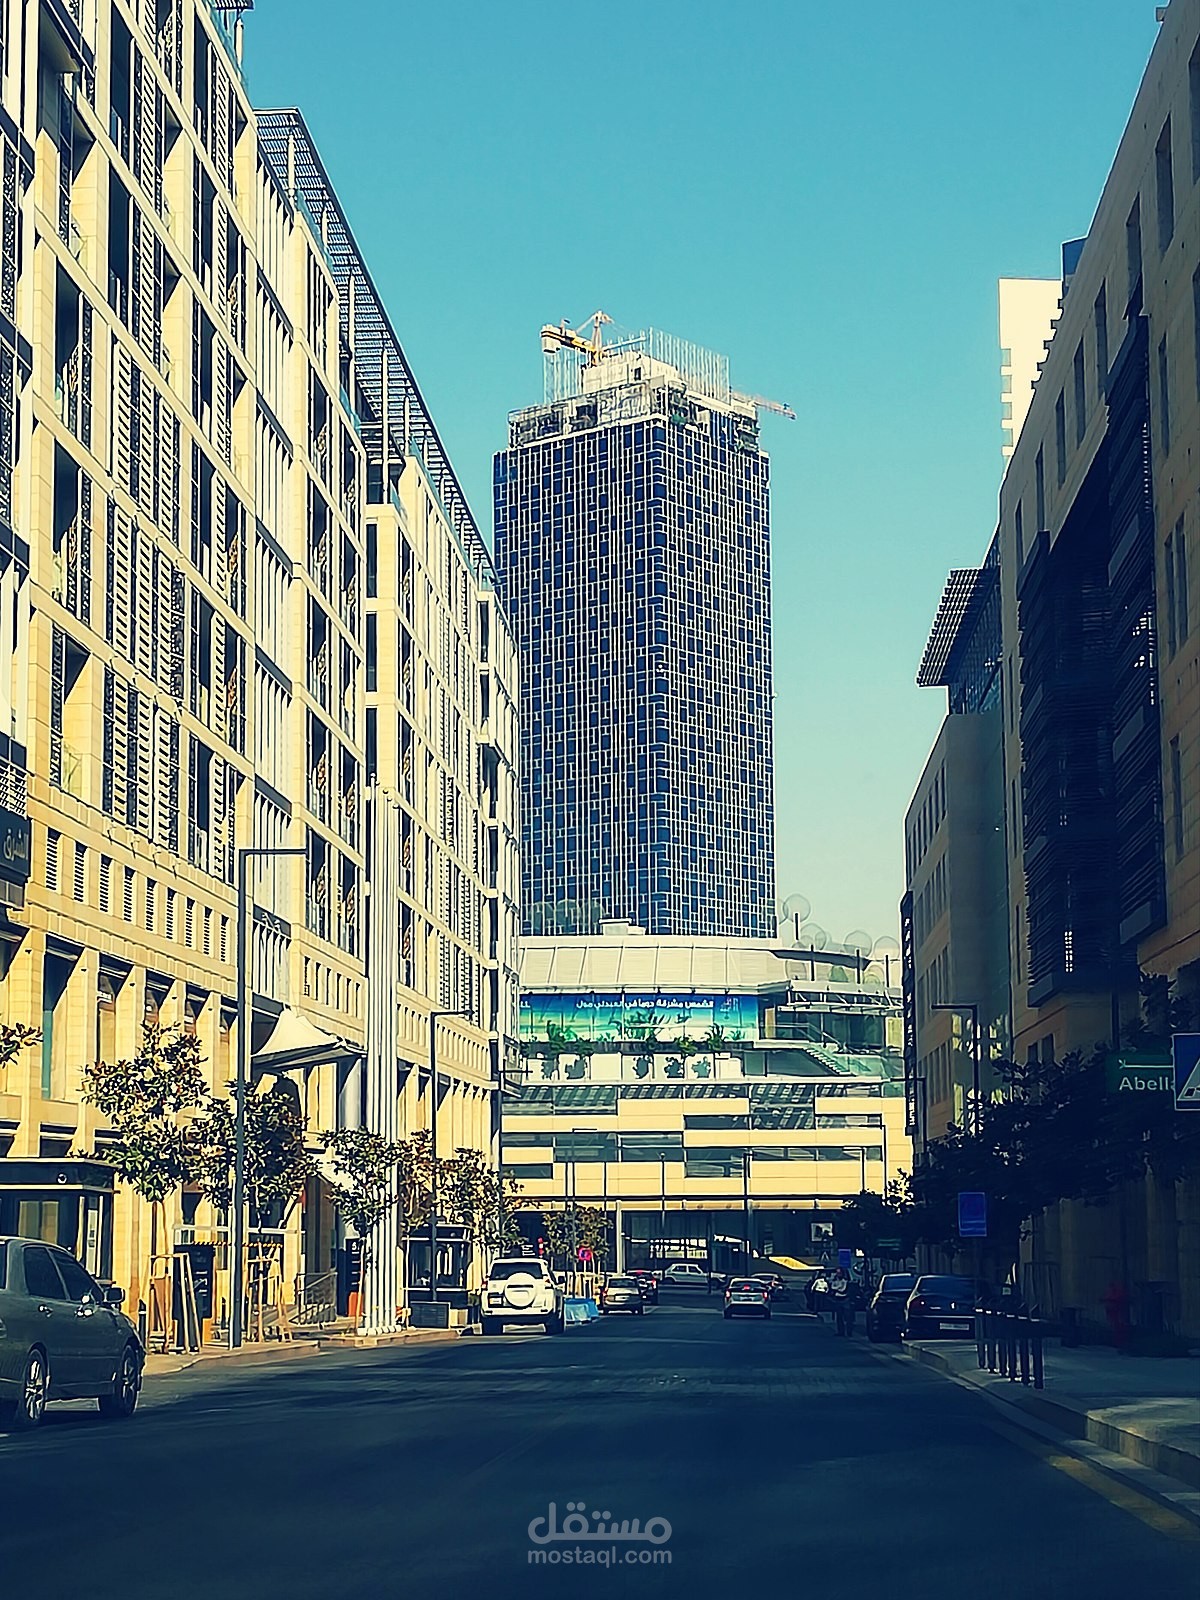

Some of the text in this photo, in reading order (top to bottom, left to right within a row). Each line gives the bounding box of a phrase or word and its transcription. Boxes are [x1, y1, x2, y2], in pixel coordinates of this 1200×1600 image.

[576, 1000, 593, 1008] مول
[624, 999, 638, 1010] في
[656, 998, 684, 1008] مشرقة
[684, 999, 714, 1008] الشمس
